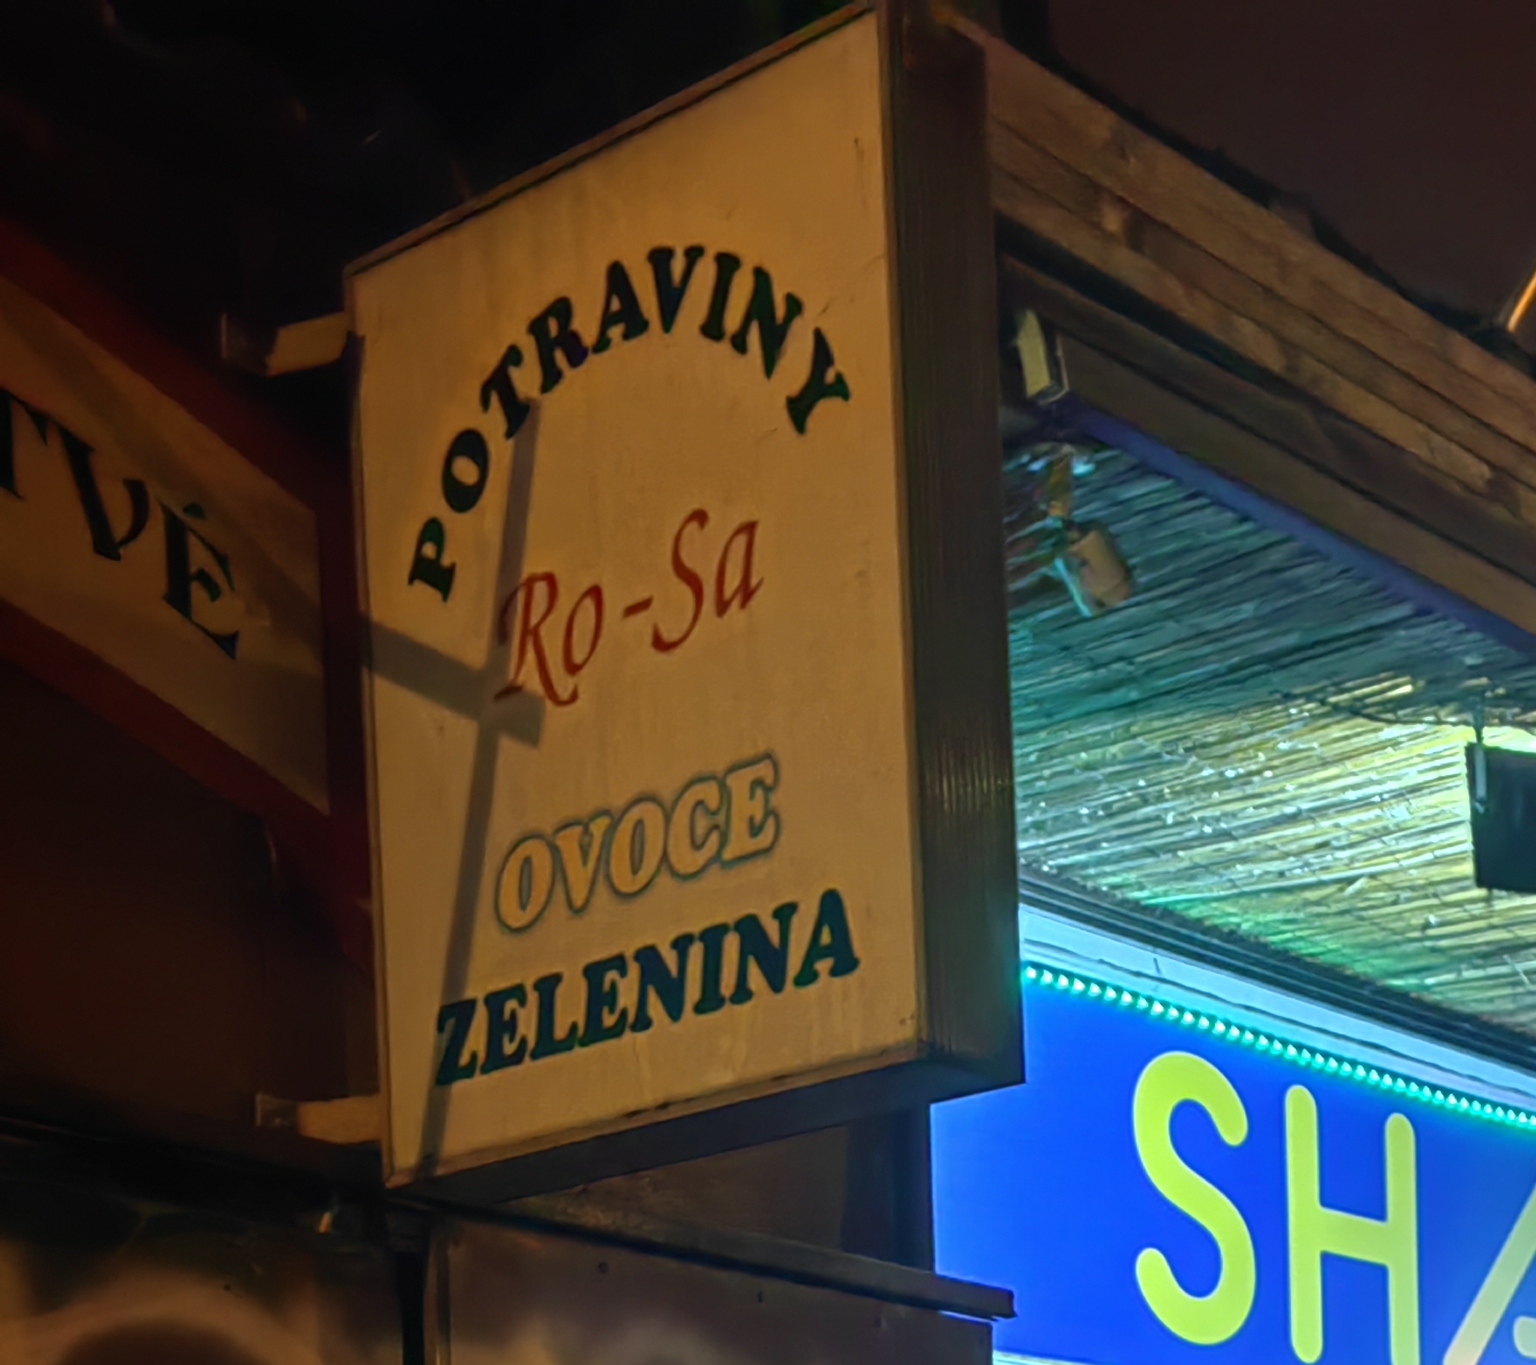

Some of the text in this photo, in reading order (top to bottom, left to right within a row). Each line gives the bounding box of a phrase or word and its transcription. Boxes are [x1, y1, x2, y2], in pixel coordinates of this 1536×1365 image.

[407, 244, 851, 602] POTRAVINY
[492, 507, 765, 709] Ro-Sa
[493, 751, 783, 936] OVOCE
[434, 887, 860, 1087] ZELENINA
